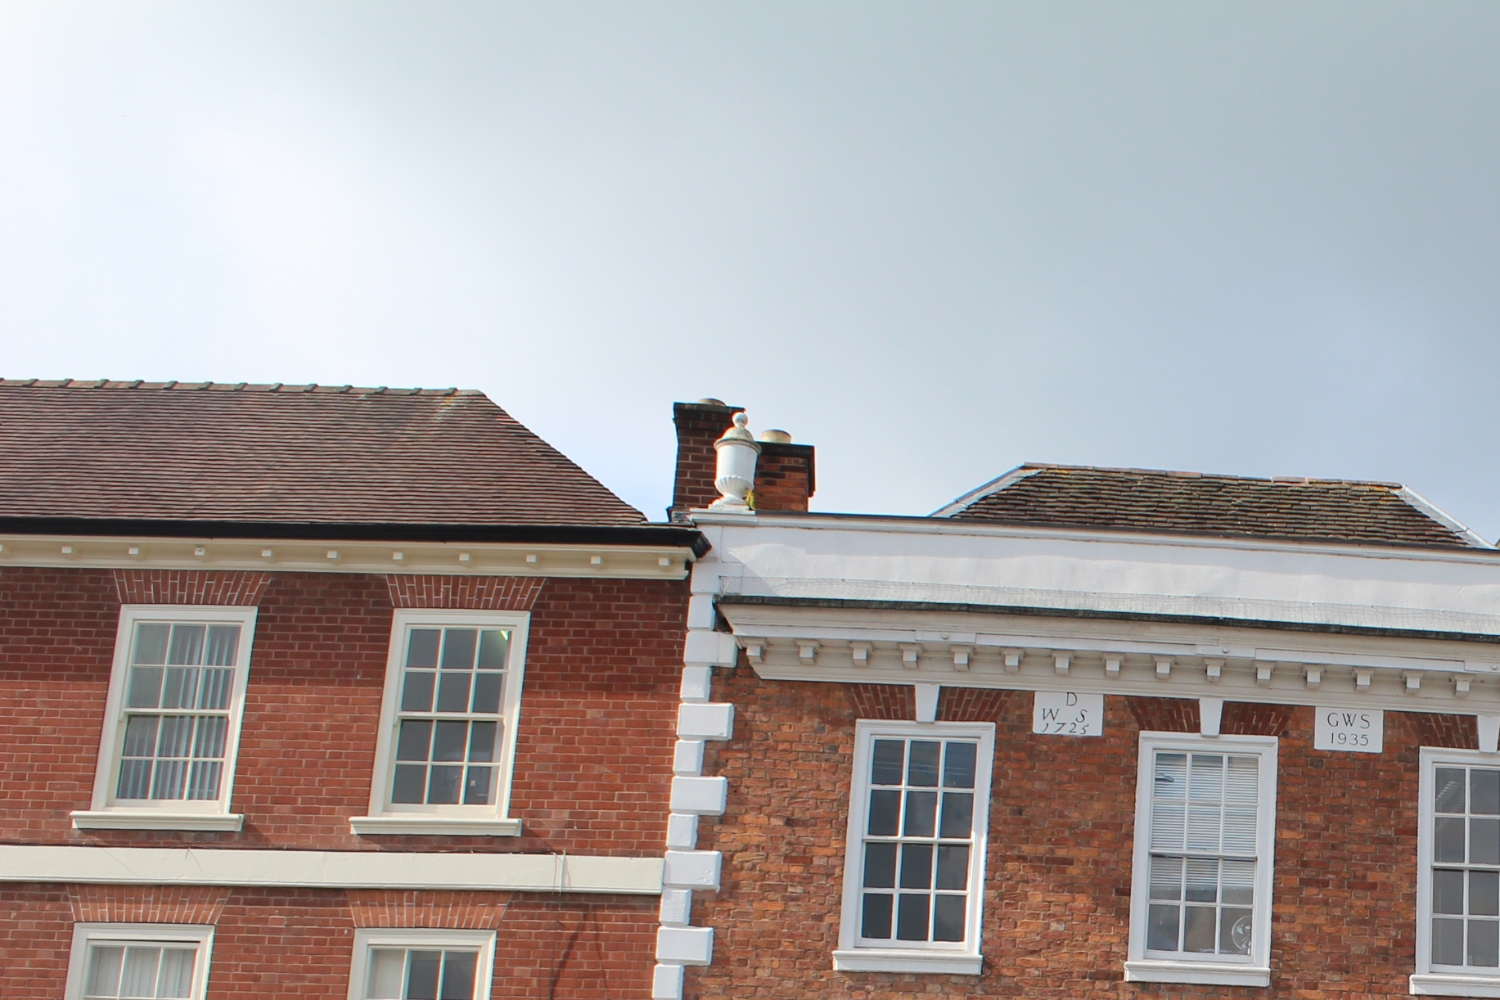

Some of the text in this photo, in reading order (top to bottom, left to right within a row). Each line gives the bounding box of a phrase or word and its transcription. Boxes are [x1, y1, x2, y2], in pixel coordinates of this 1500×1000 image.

[1066, 692, 1077, 706] D
[1042, 708, 1088, 723] W S
[1327, 712, 1370, 729] GWS
[1331, 732, 1369, 746] 1935
